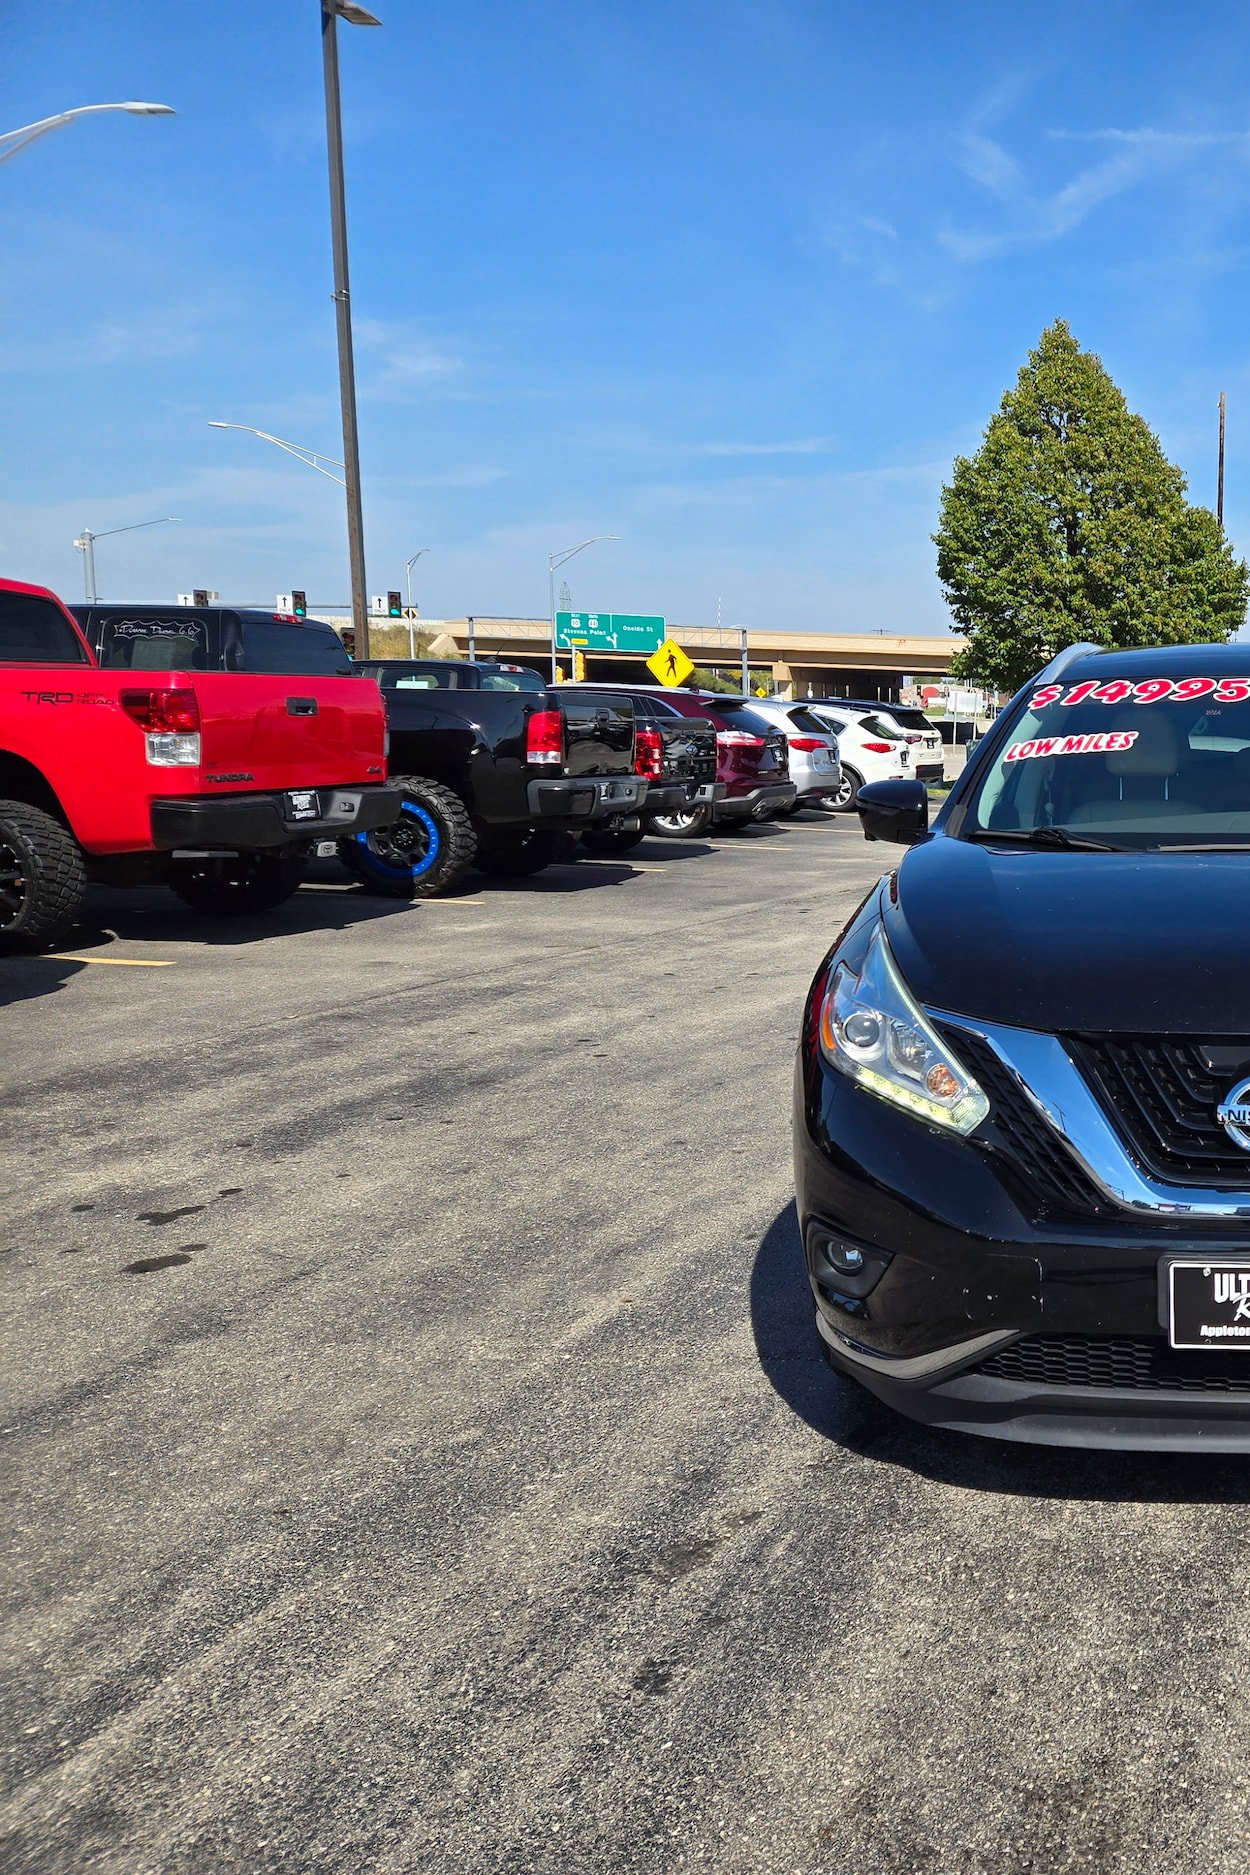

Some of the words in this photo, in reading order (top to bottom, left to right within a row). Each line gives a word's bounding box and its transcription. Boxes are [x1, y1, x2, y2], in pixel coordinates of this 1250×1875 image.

[20, 692, 74, 706] TRD
[1005, 737, 1057, 761] LOW
[1060, 731, 1138, 752] MILES
[206, 773, 254, 784] TUNDRA
